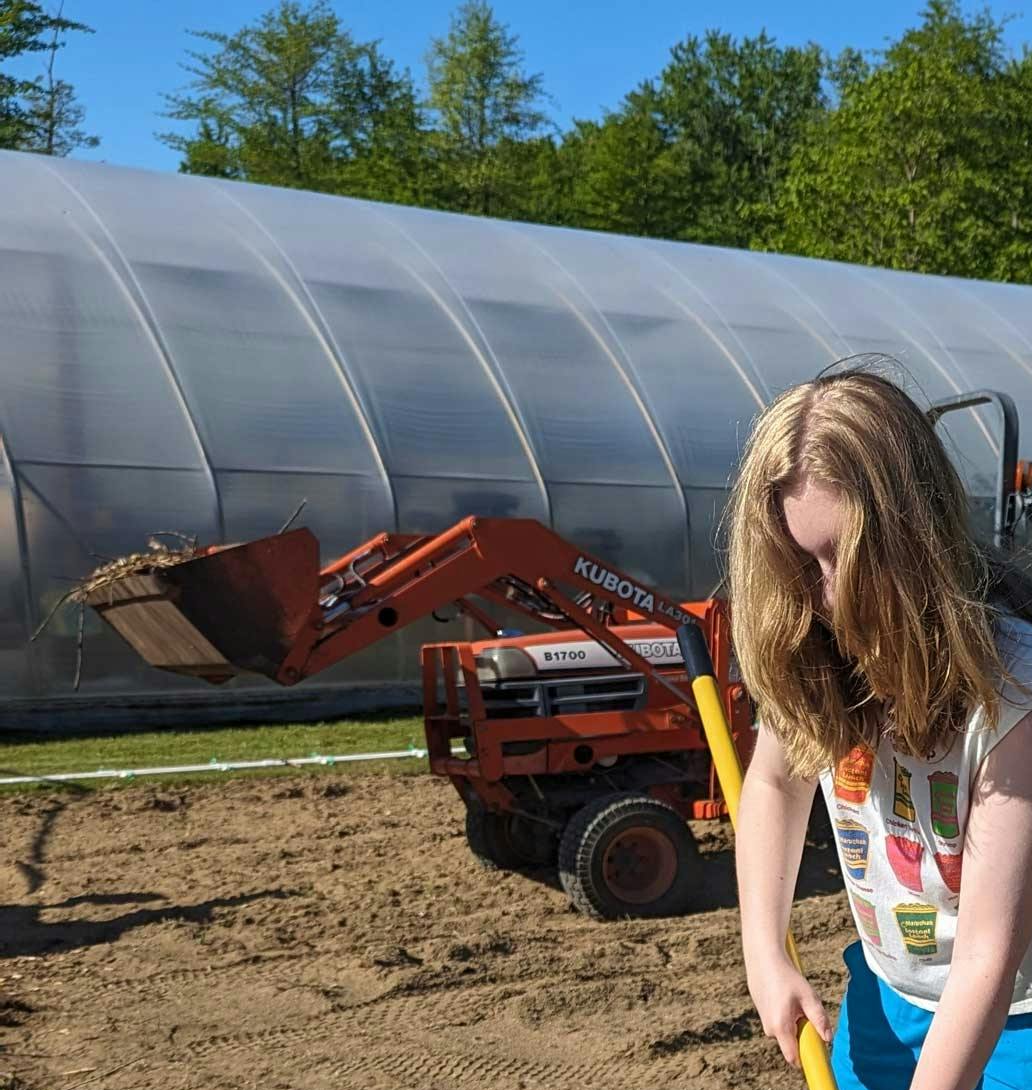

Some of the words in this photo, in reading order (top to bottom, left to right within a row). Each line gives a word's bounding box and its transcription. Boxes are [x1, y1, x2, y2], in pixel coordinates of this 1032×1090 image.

[574, 556, 655, 614] KUBOTA
[543, 650, 587, 662] B1700
[629, 642, 682, 658] UBOTA
